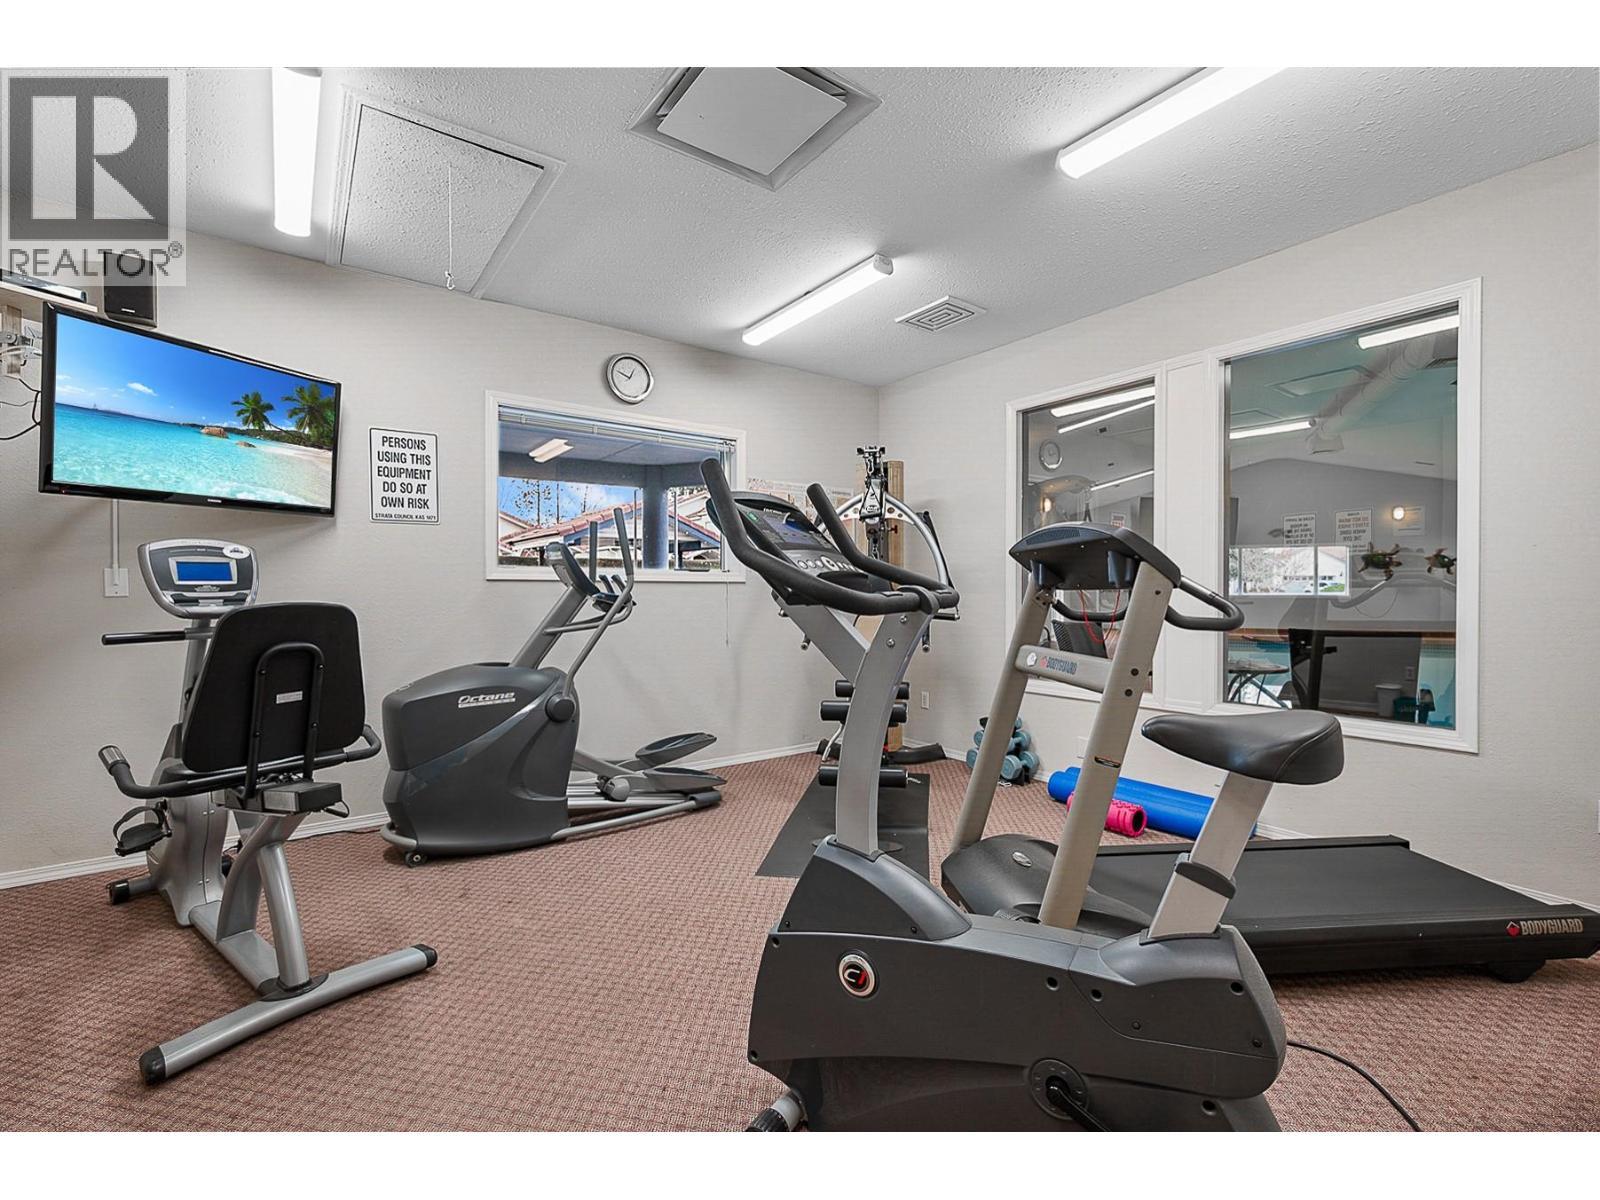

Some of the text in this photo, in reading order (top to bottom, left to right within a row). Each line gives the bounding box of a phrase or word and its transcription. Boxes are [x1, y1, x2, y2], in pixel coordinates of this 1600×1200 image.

[382, 436, 426, 451] PERSONS
[377, 450, 431, 466] USING THIS
[377, 465, 432, 480] EQUIPMENT
[382, 481, 427, 495] DO SO AT
[381, 496, 430, 510] OWN RISK
[458, 692, 516, 704] Octane
[1520, 918, 1584, 936] BODYGUARD
